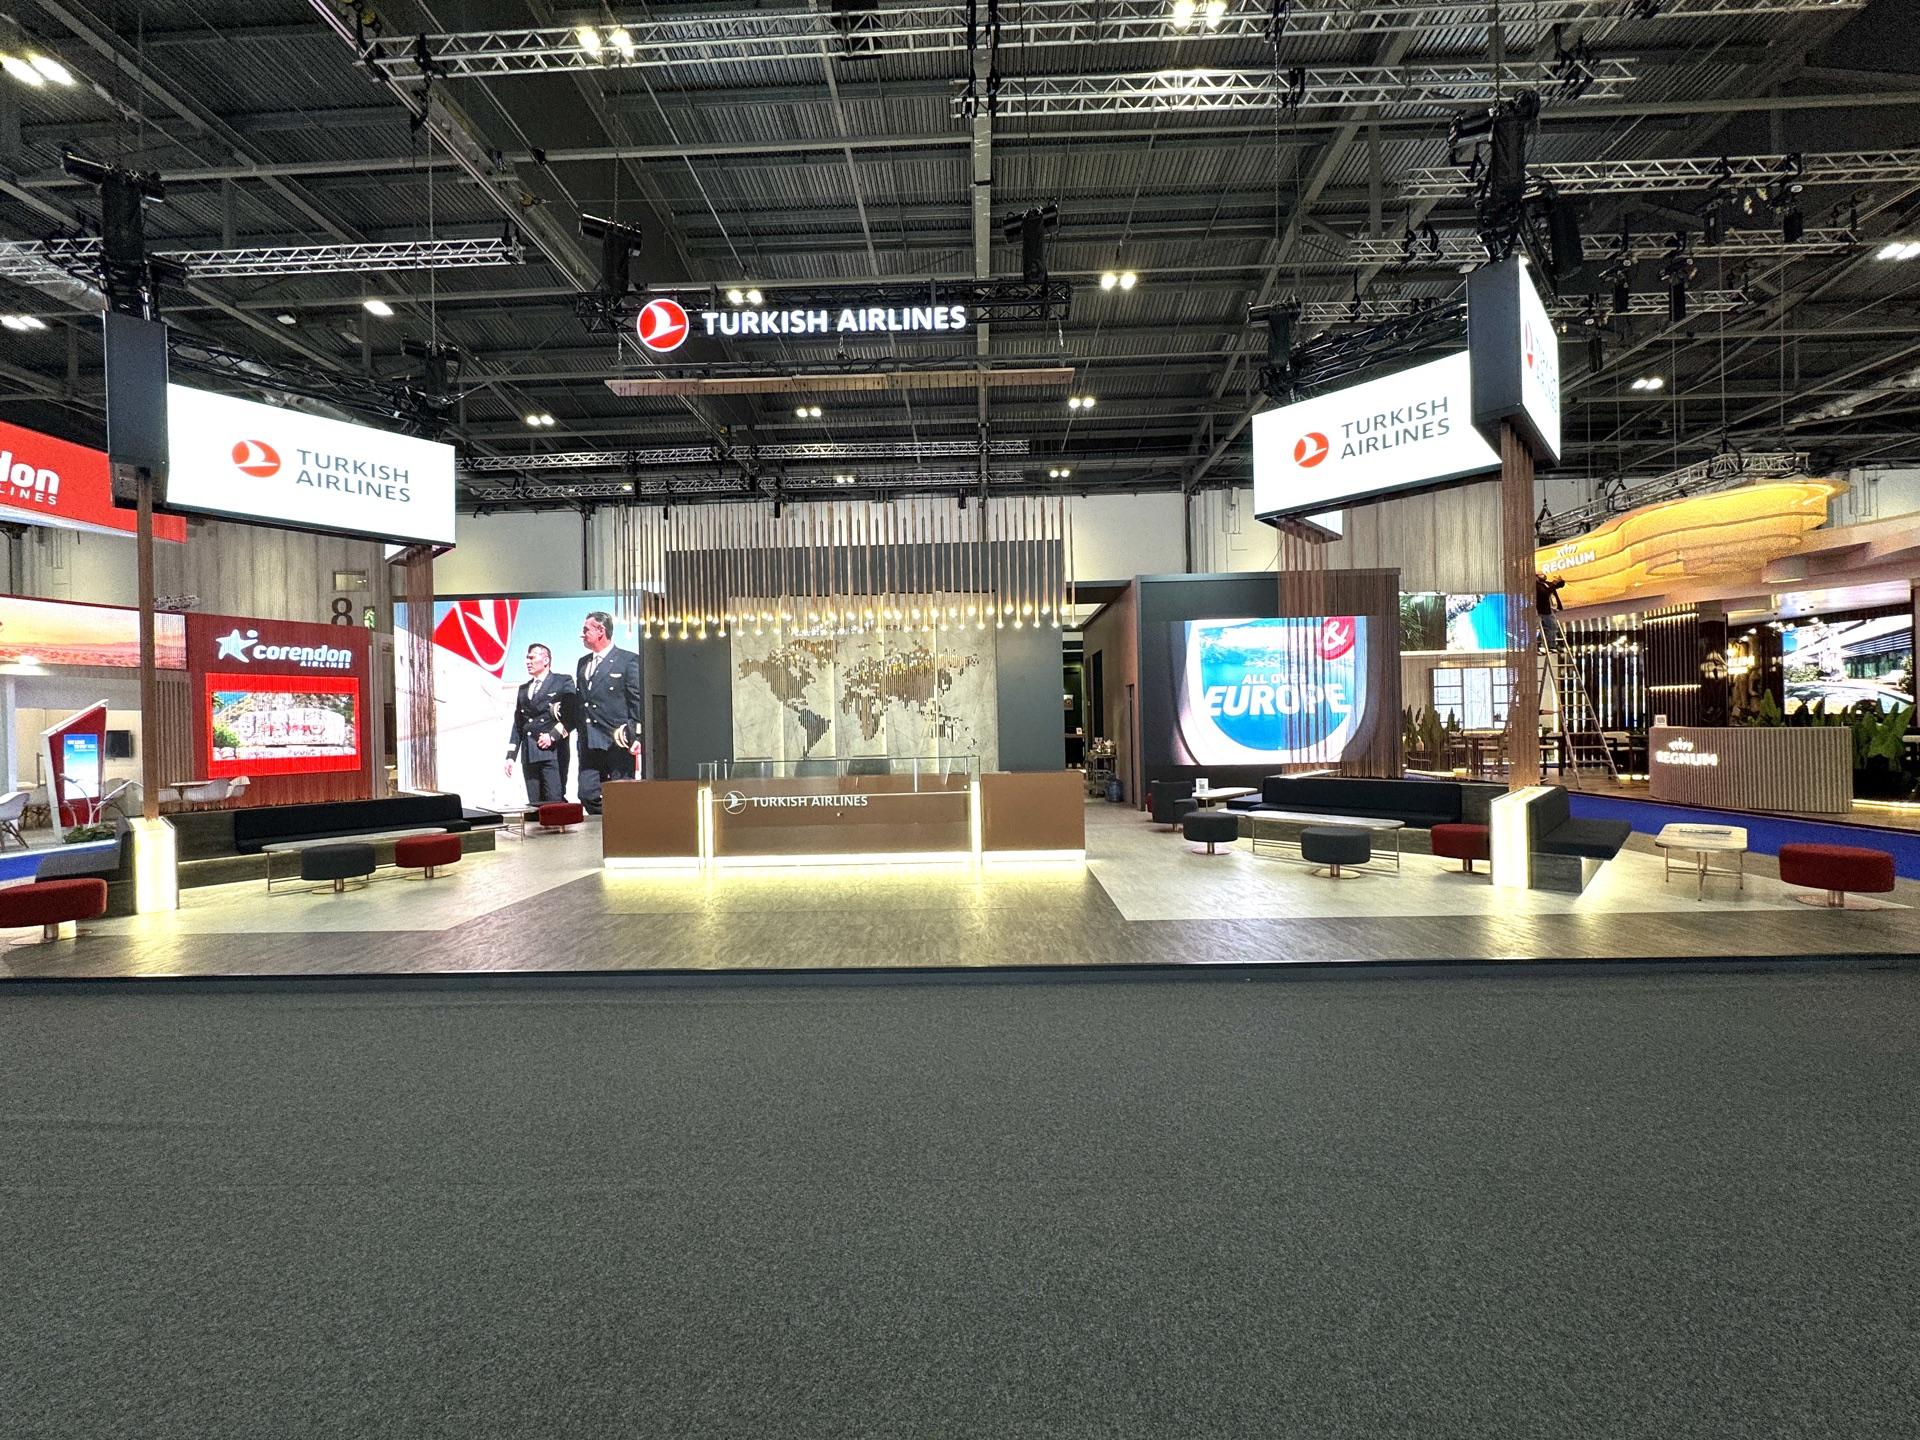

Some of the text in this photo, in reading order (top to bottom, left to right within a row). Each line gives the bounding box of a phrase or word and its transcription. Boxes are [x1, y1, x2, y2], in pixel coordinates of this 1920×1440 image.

[701, 306, 965, 335] TURKISH AIRLINES
[1341, 397, 1448, 438] TURKISH
[1341, 417, 1450, 459] AIRLINES
[296, 448, 408, 484] TURKISH
[296, 469, 410, 502] AIRLINES
[1541, 550, 1596, 574] REGNUM
[252, 644, 352, 663] corendon
[300, 660, 350, 669] AIRLINES
[1241, 673, 1268, 685] ALL
[1204, 683, 1352, 716] EUROPE
[752, 796, 868, 807] TURKISH AIRLINES
